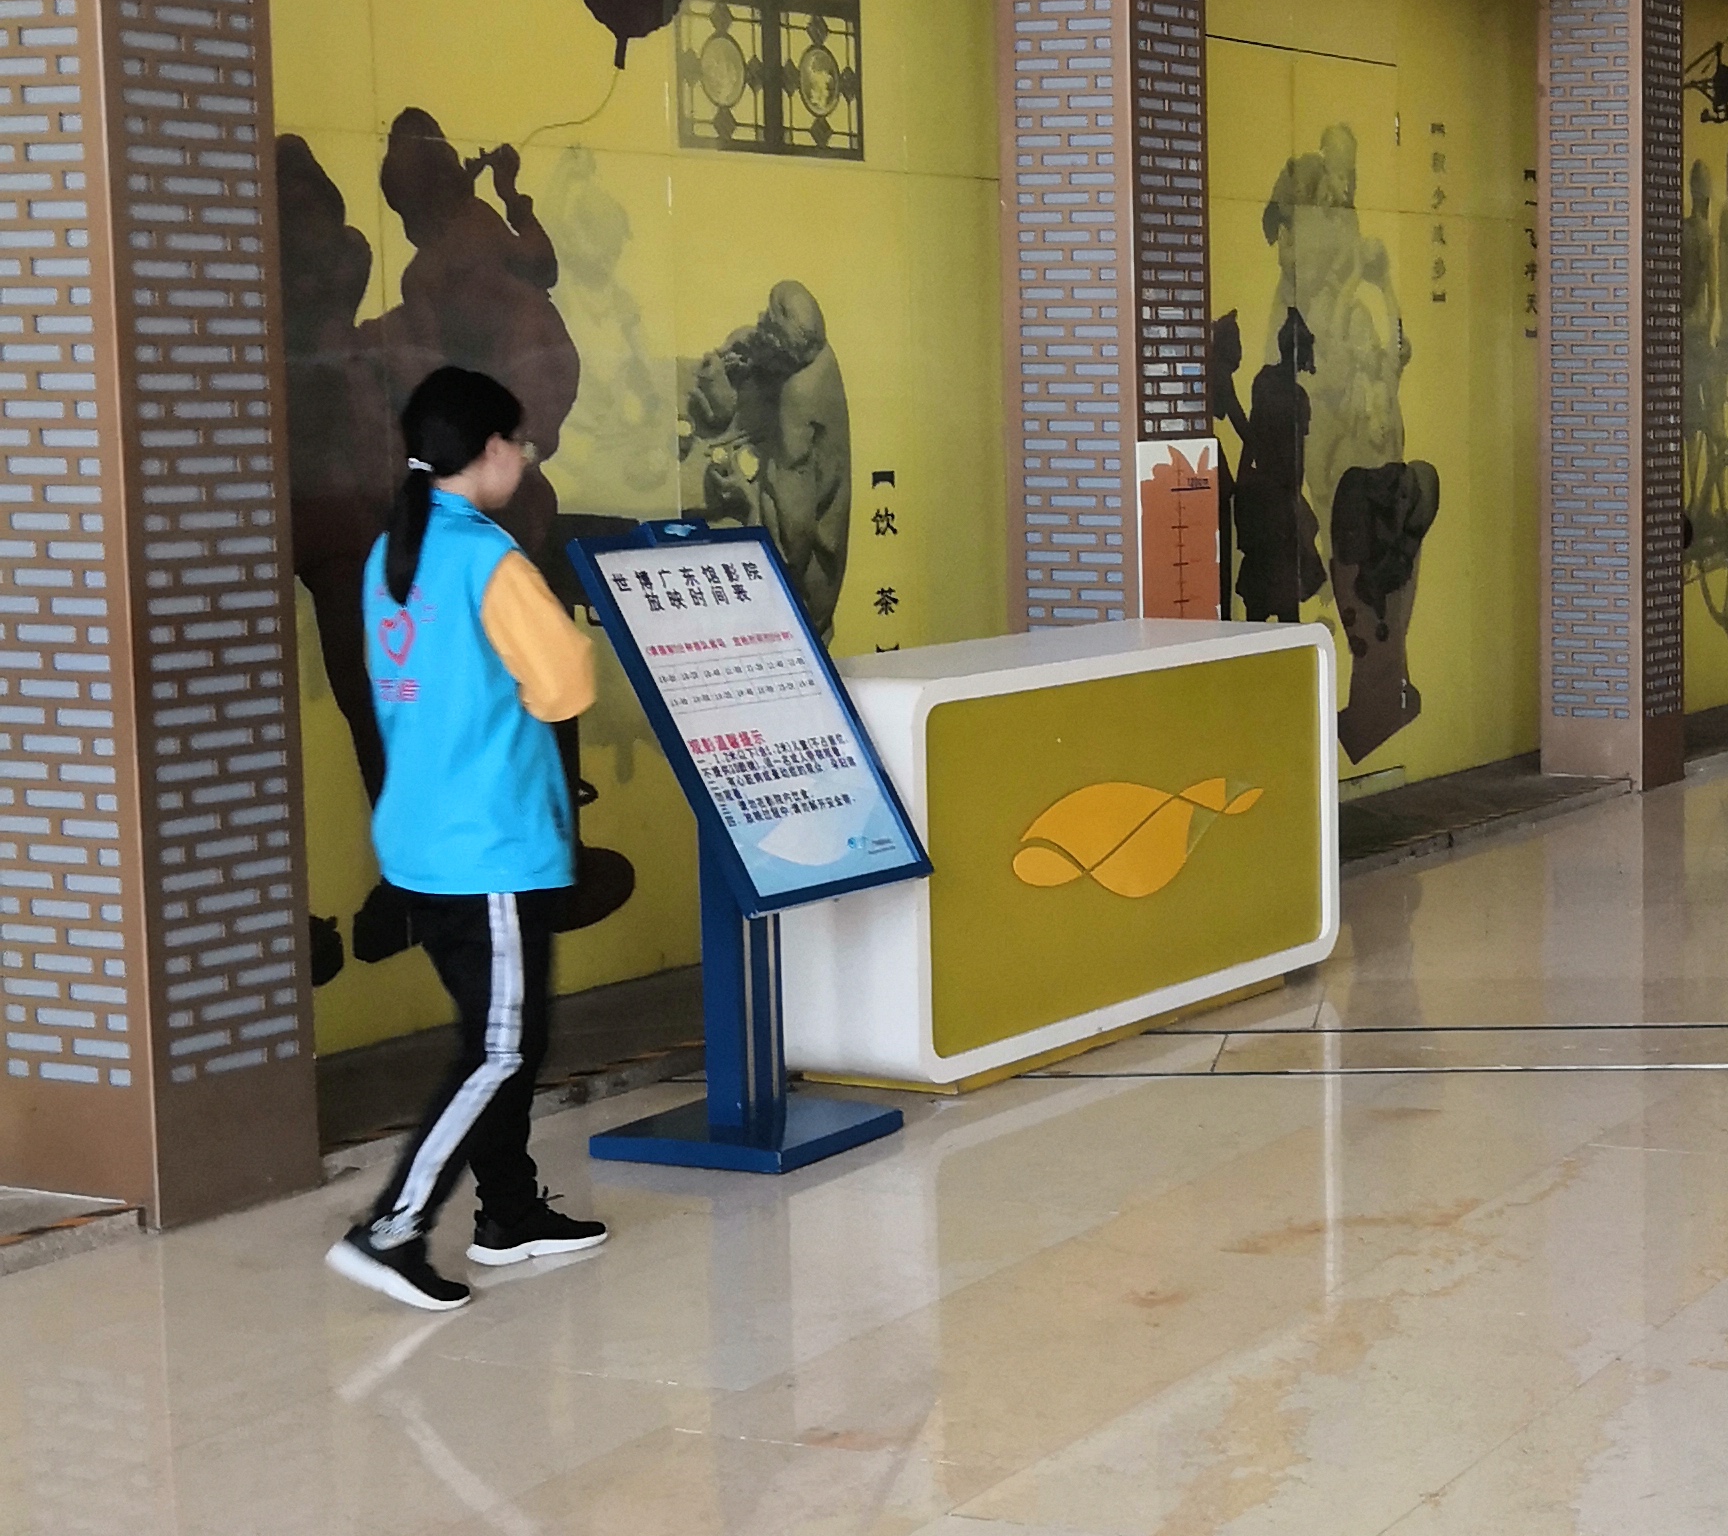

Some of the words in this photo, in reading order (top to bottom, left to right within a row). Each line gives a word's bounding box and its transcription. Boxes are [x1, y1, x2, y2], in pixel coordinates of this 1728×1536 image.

[611, 560, 763, 592] 世博广东馆影院
[644, 584, 753, 612] 放映时间表
